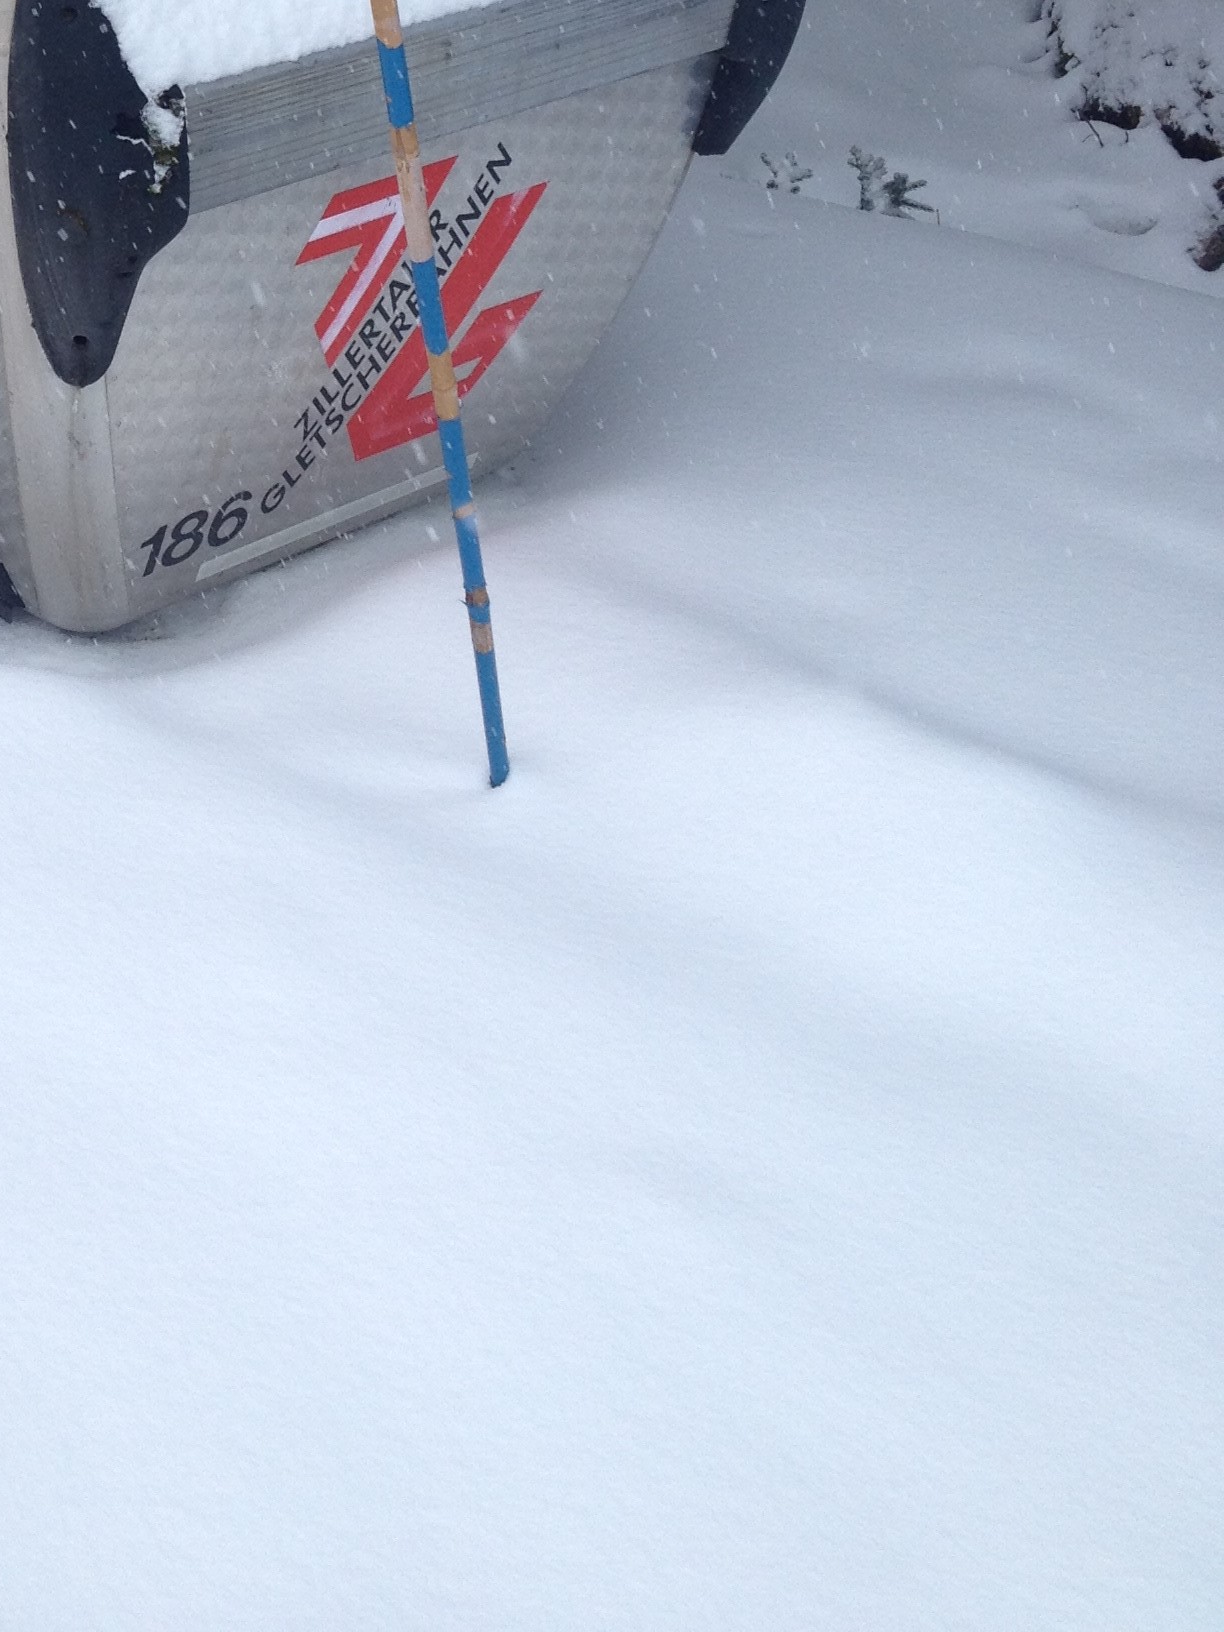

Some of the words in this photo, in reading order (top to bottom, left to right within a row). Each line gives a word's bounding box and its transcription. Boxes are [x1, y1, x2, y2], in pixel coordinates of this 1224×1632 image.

[261, 142, 512, 515] GLETSCHERBHNEN
[294, 208, 449, 442] ZILLERTALR
[139, 490, 252, 577] 186
